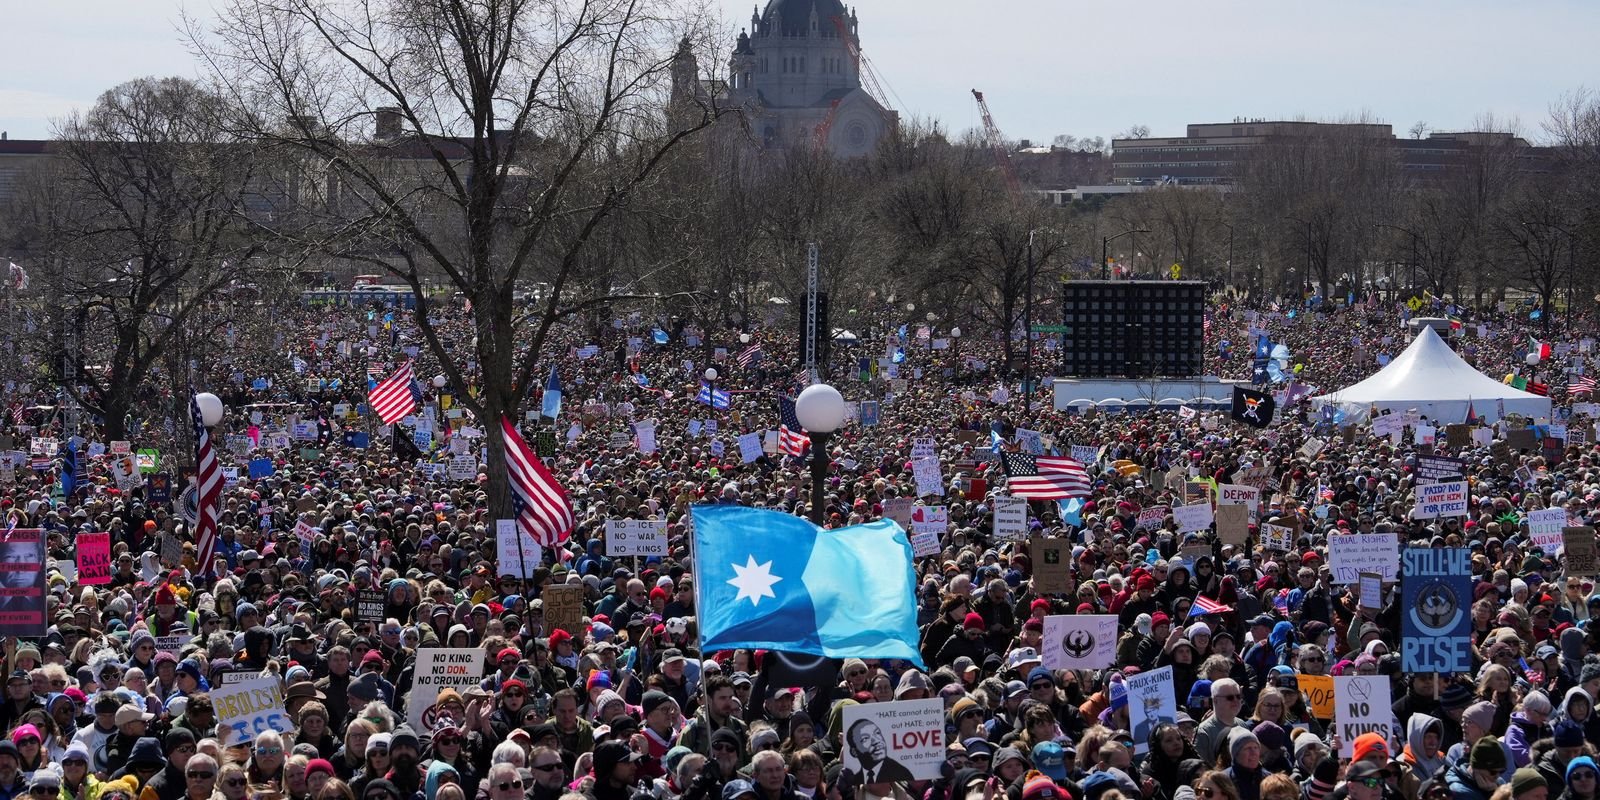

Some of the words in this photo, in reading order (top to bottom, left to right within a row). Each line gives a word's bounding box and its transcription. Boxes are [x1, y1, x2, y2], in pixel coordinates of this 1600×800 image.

[1223, 489, 1256, 500] DEPORT
[1424, 485, 1447, 495] PAID?
[1448, 484, 1461, 492] NO
[1428, 494, 1445, 503] HATE
[1446, 493, 1461, 501] HIM
[1423, 505, 1439, 513] FOR
[1440, 502, 1465, 512] FREE!
[1141, 510, 1165, 520] PEOPLE
[1543, 511, 1564, 521] KINGS
[1531, 525, 1542, 533] NO
[1545, 523, 1561, 533] ICE
[79, 534, 108, 544] BRING
[1332, 536, 1358, 545] EQUAL
[1361, 535, 1389, 544] RIGHTS
[1533, 535, 1547, 544] NO
[614, 545, 627, 553] NO
[637, 545, 662, 553] KINGS
[82, 555, 109, 567] BACK
[79, 567, 111, 580] AGAIN
[548, 588, 583, 606] ICE
[358, 602, 366, 610] NO
[367, 602, 384, 611] KINGS
[363, 610, 384, 618] AMERICA
[544, 607, 581, 623] OUT
[433, 654, 447, 664] NO
[449, 654, 474, 664] KING.
[1402, 636, 1472, 673] RISE
[431, 666, 445, 675] NO
[446, 666, 469, 675] DON.
[418, 676, 432, 685] NO
[433, 676, 480, 685] CROWNED
[1128, 671, 1171, 691] FAUX-KING
[1142, 684, 1159, 696] JOKE
[215, 684, 285, 722] ABOLISH
[898, 710, 922, 718] cannot
[923, 707, 941, 716] drive
[1349, 702, 1370, 718] NO
[231, 713, 284, 743] ICE
[891, 722, 903, 730] out
[925, 719, 941, 729] only
[892, 729, 942, 751] LOVE
[914, 751, 924, 760] do
